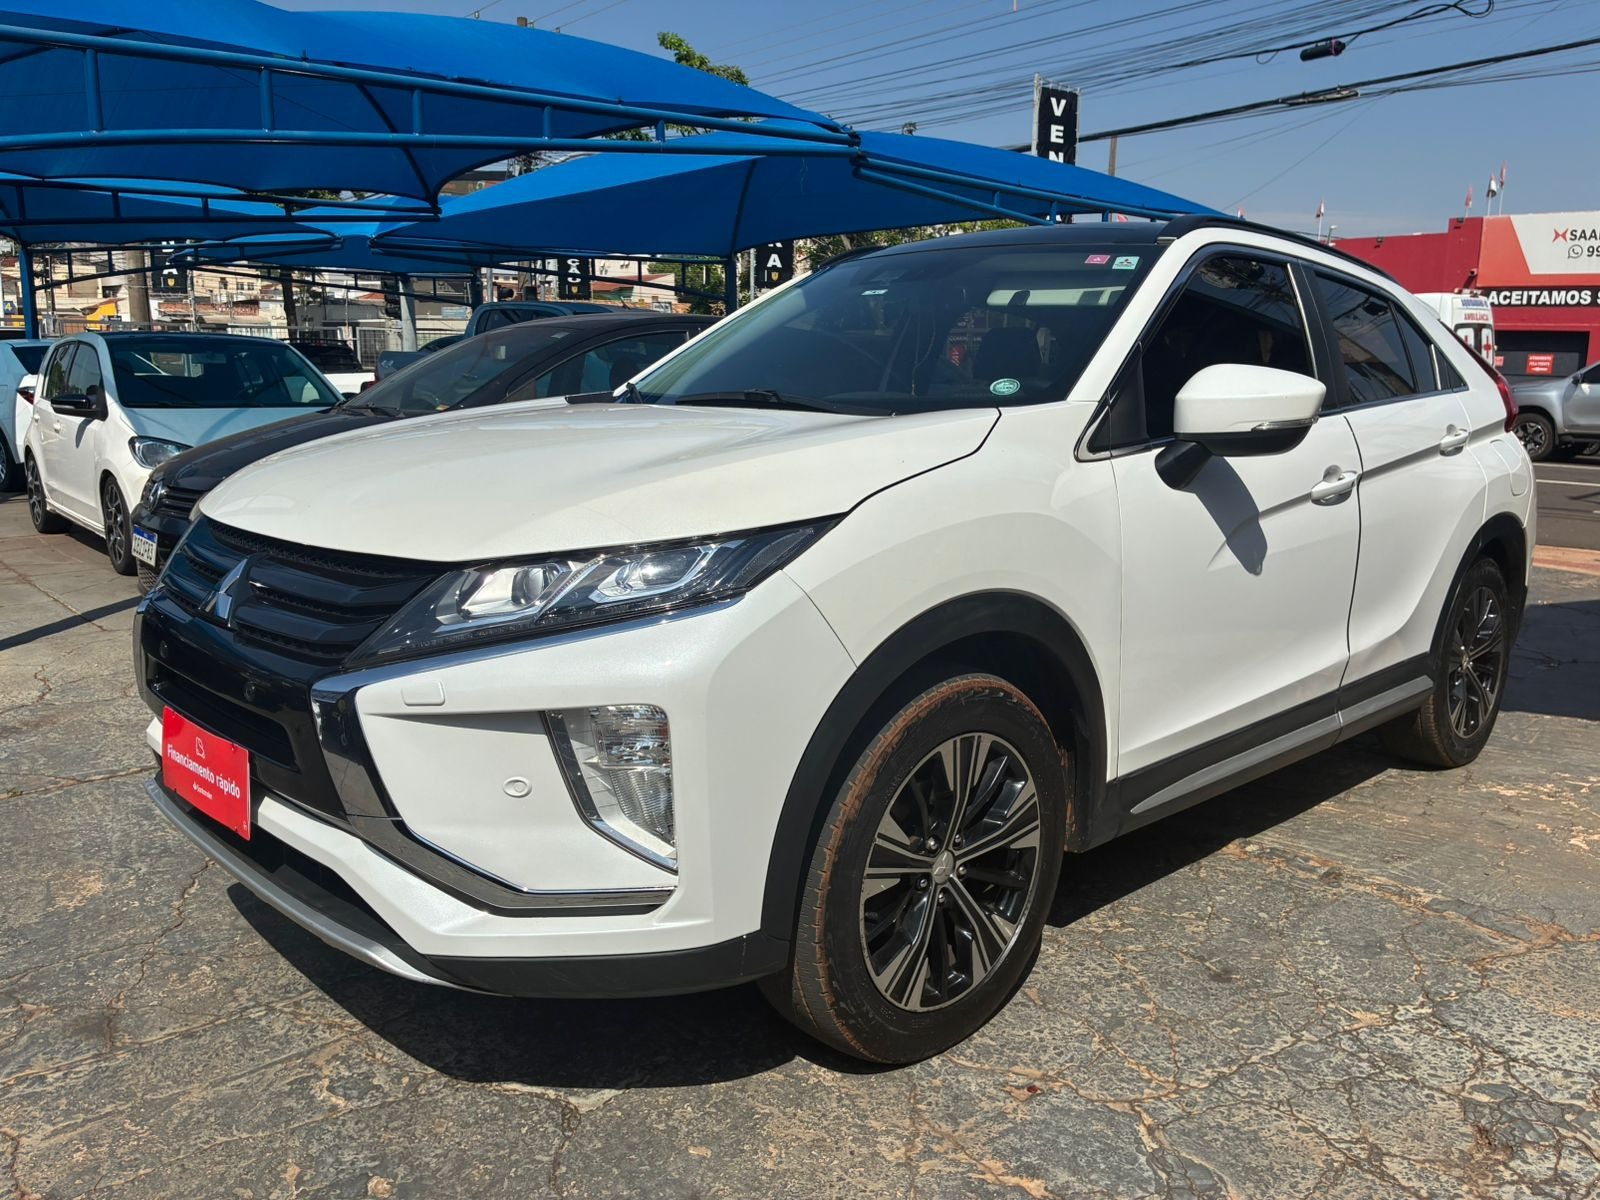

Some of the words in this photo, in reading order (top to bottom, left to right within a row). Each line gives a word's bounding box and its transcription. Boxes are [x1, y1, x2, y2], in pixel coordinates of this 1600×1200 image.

[1048, 97, 1067, 164] VEN
[1569, 229, 1600, 241] SAA
[1487, 290, 1592, 305] ACEITAMOS
[167, 743, 215, 784] Financiamento
[216, 772, 240, 799] rápido
